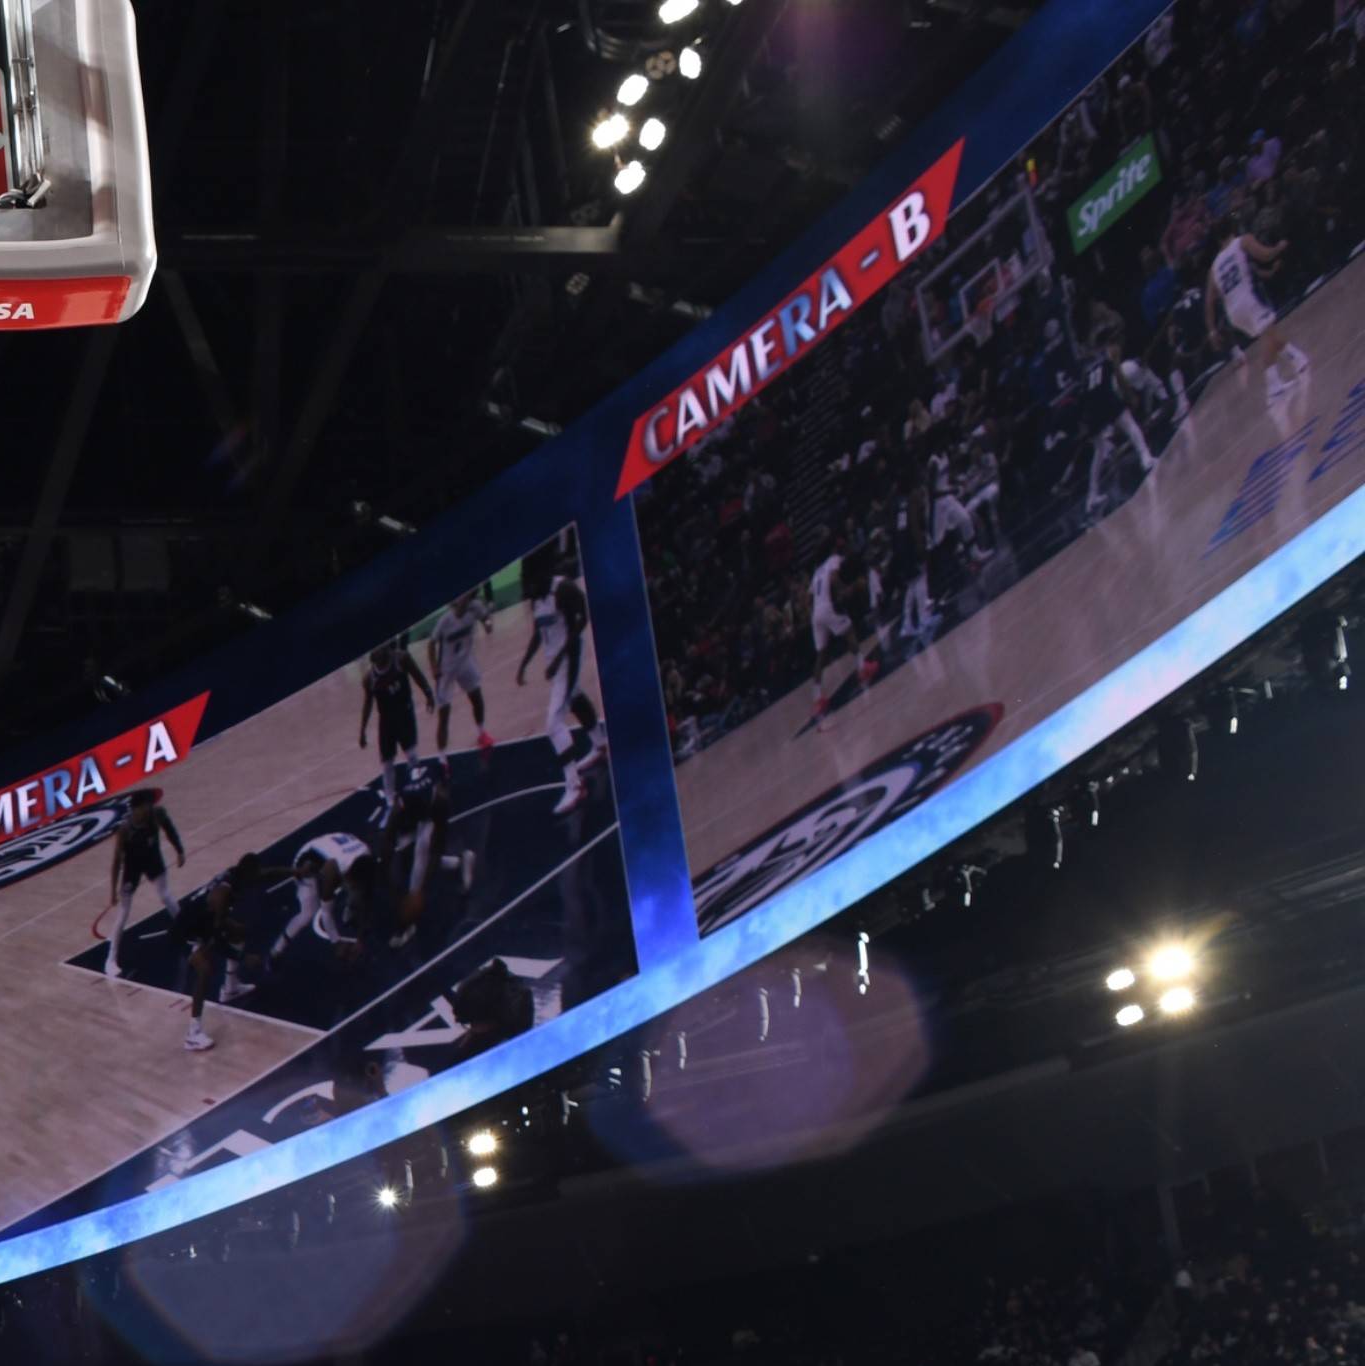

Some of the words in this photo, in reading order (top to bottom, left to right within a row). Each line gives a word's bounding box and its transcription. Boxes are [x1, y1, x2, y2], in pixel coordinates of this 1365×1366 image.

[1077, 153, 1152, 239] Sprite
[643, 268, 854, 465] CAMERA
[887, 190, 932, 263] B
[143, 721, 179, 773] A
